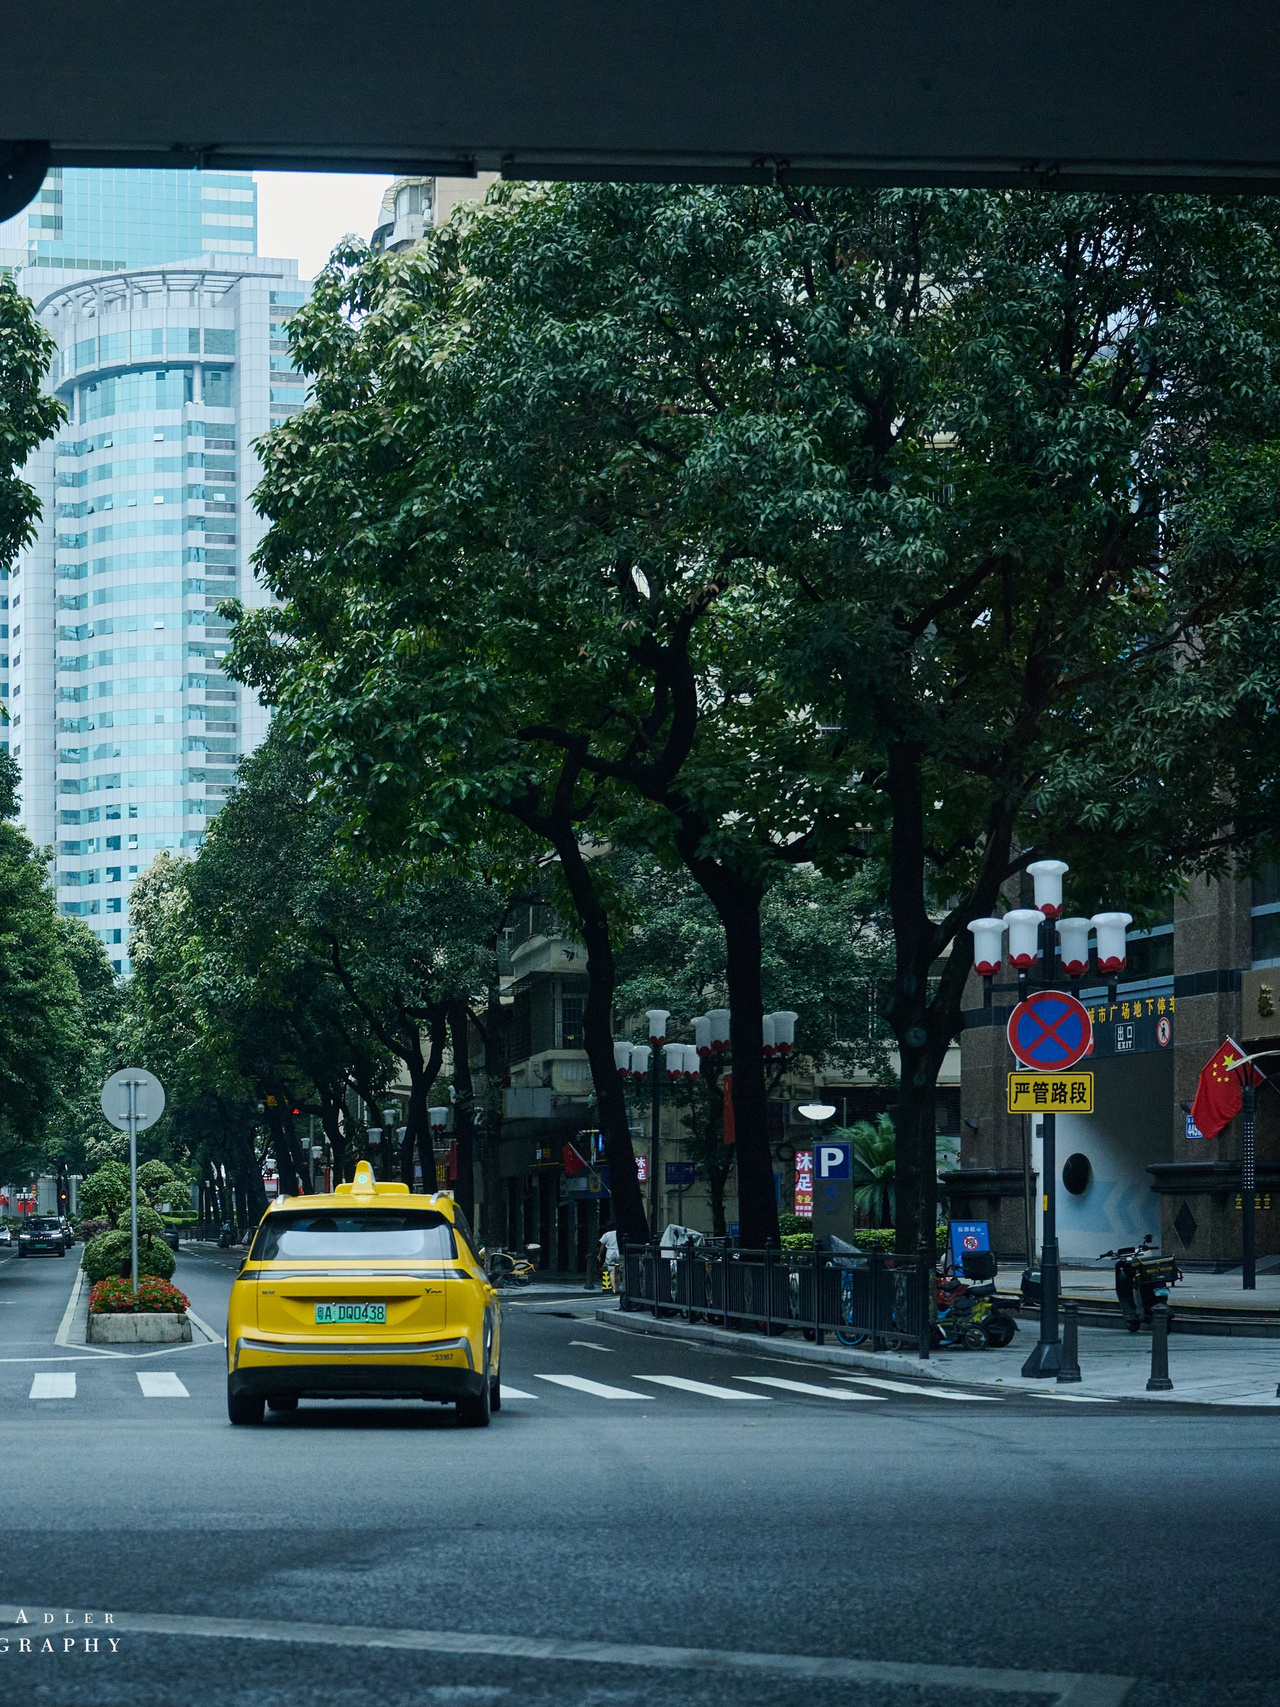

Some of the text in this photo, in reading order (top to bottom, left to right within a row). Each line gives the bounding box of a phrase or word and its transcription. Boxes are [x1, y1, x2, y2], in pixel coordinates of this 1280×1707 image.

[1116, 1025, 1133, 1042] 出口
[1117, 1040, 1133, 1050] EXIT
[1012, 1080, 1089, 1106] 严管路段
[795, 1152, 813, 1192] 沐足
[820, 1147, 845, 1178] P
